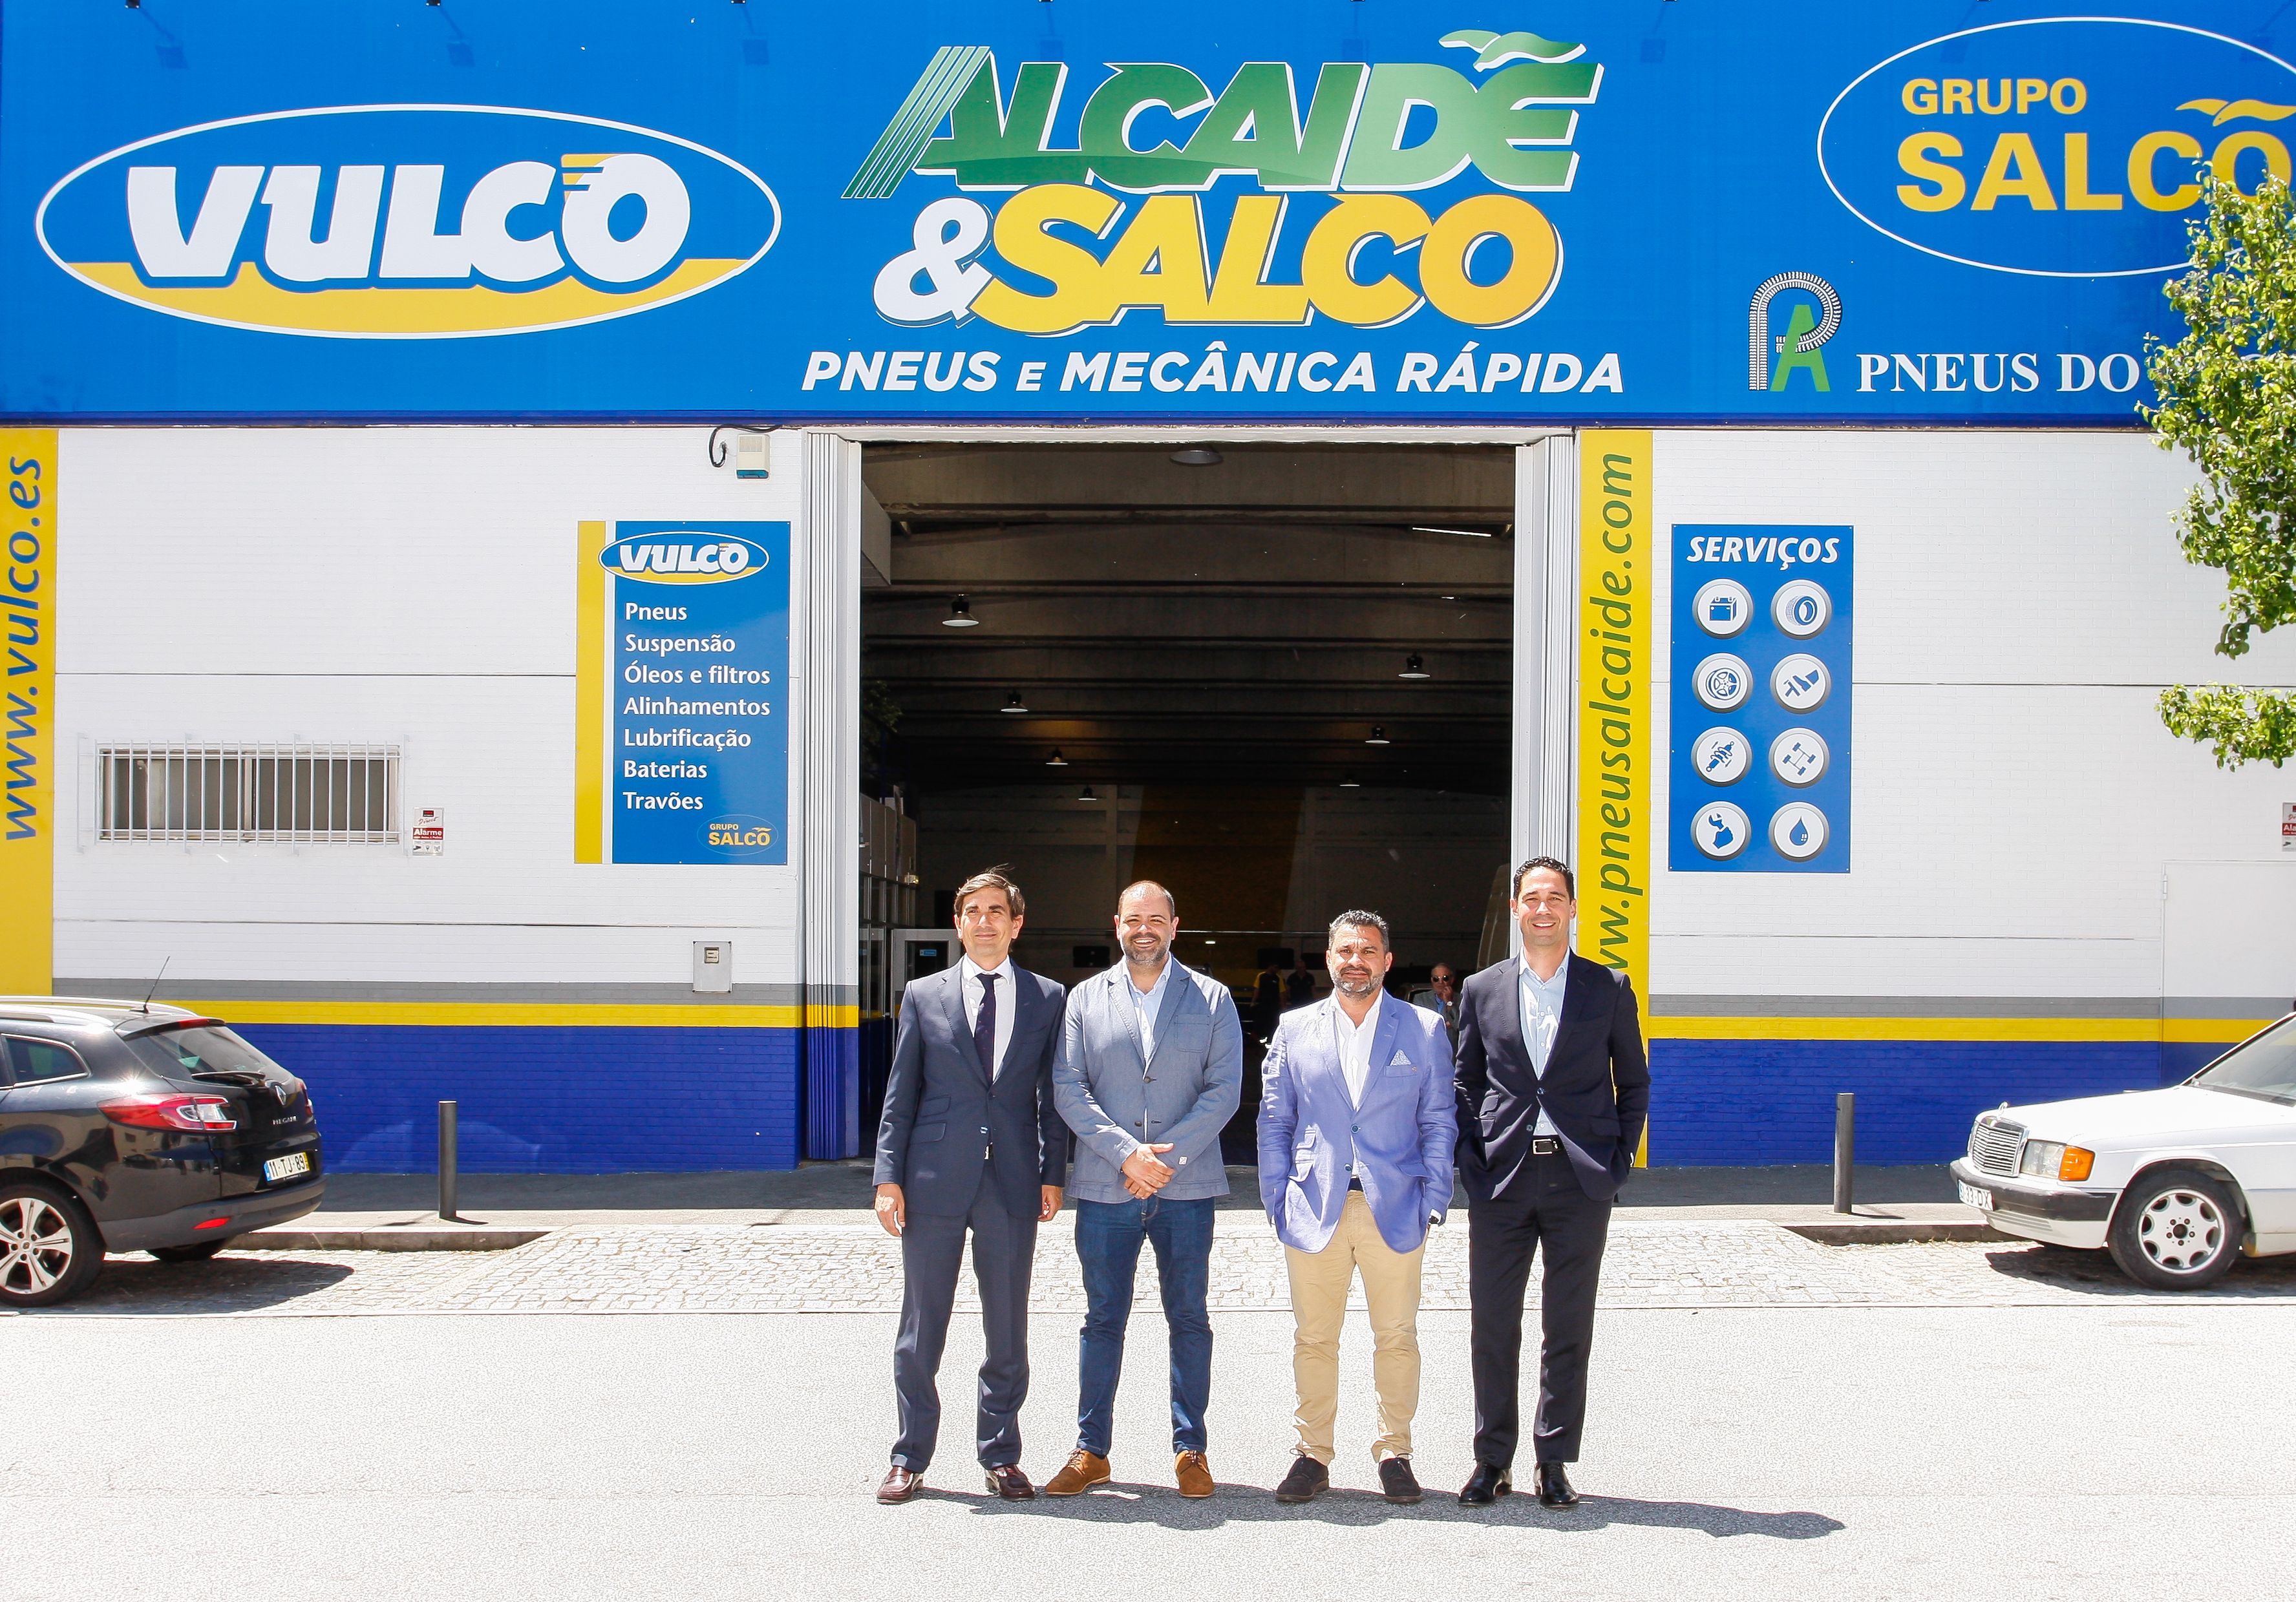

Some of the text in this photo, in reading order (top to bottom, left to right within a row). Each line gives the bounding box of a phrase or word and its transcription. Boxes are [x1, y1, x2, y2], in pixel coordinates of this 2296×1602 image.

[1902, 78, 2087, 115] GRUPO
[842, 44, 1604, 198] ALCAIDE
[1897, 131, 2292, 212] SALCO
[127, 154, 691, 283] VULCO
[801, 341, 1624, 393] PNEUS E MECÂNICA RÁPIDA
[1856, 353, 2140, 392] PNEUS DO
[619, 542, 750, 573] VULCO
[1686, 536, 1840, 571] SERVIÇOS
[625, 602, 687, 620] Pneus
[0, 456, 41, 840] www.vulco.es
[624, 633, 736, 657] Suspensão
[624, 659, 771, 684] Óleos e filtros
[623, 696, 771, 716] Alinhamentos
[624, 728, 751, 752] Lubrificação
[623, 760, 707, 778] Baterias
[622, 792, 703, 810] Travões
[708, 832, 771, 846] SALCO
[269, 1155, 305, 1177] 11-TJ-89
